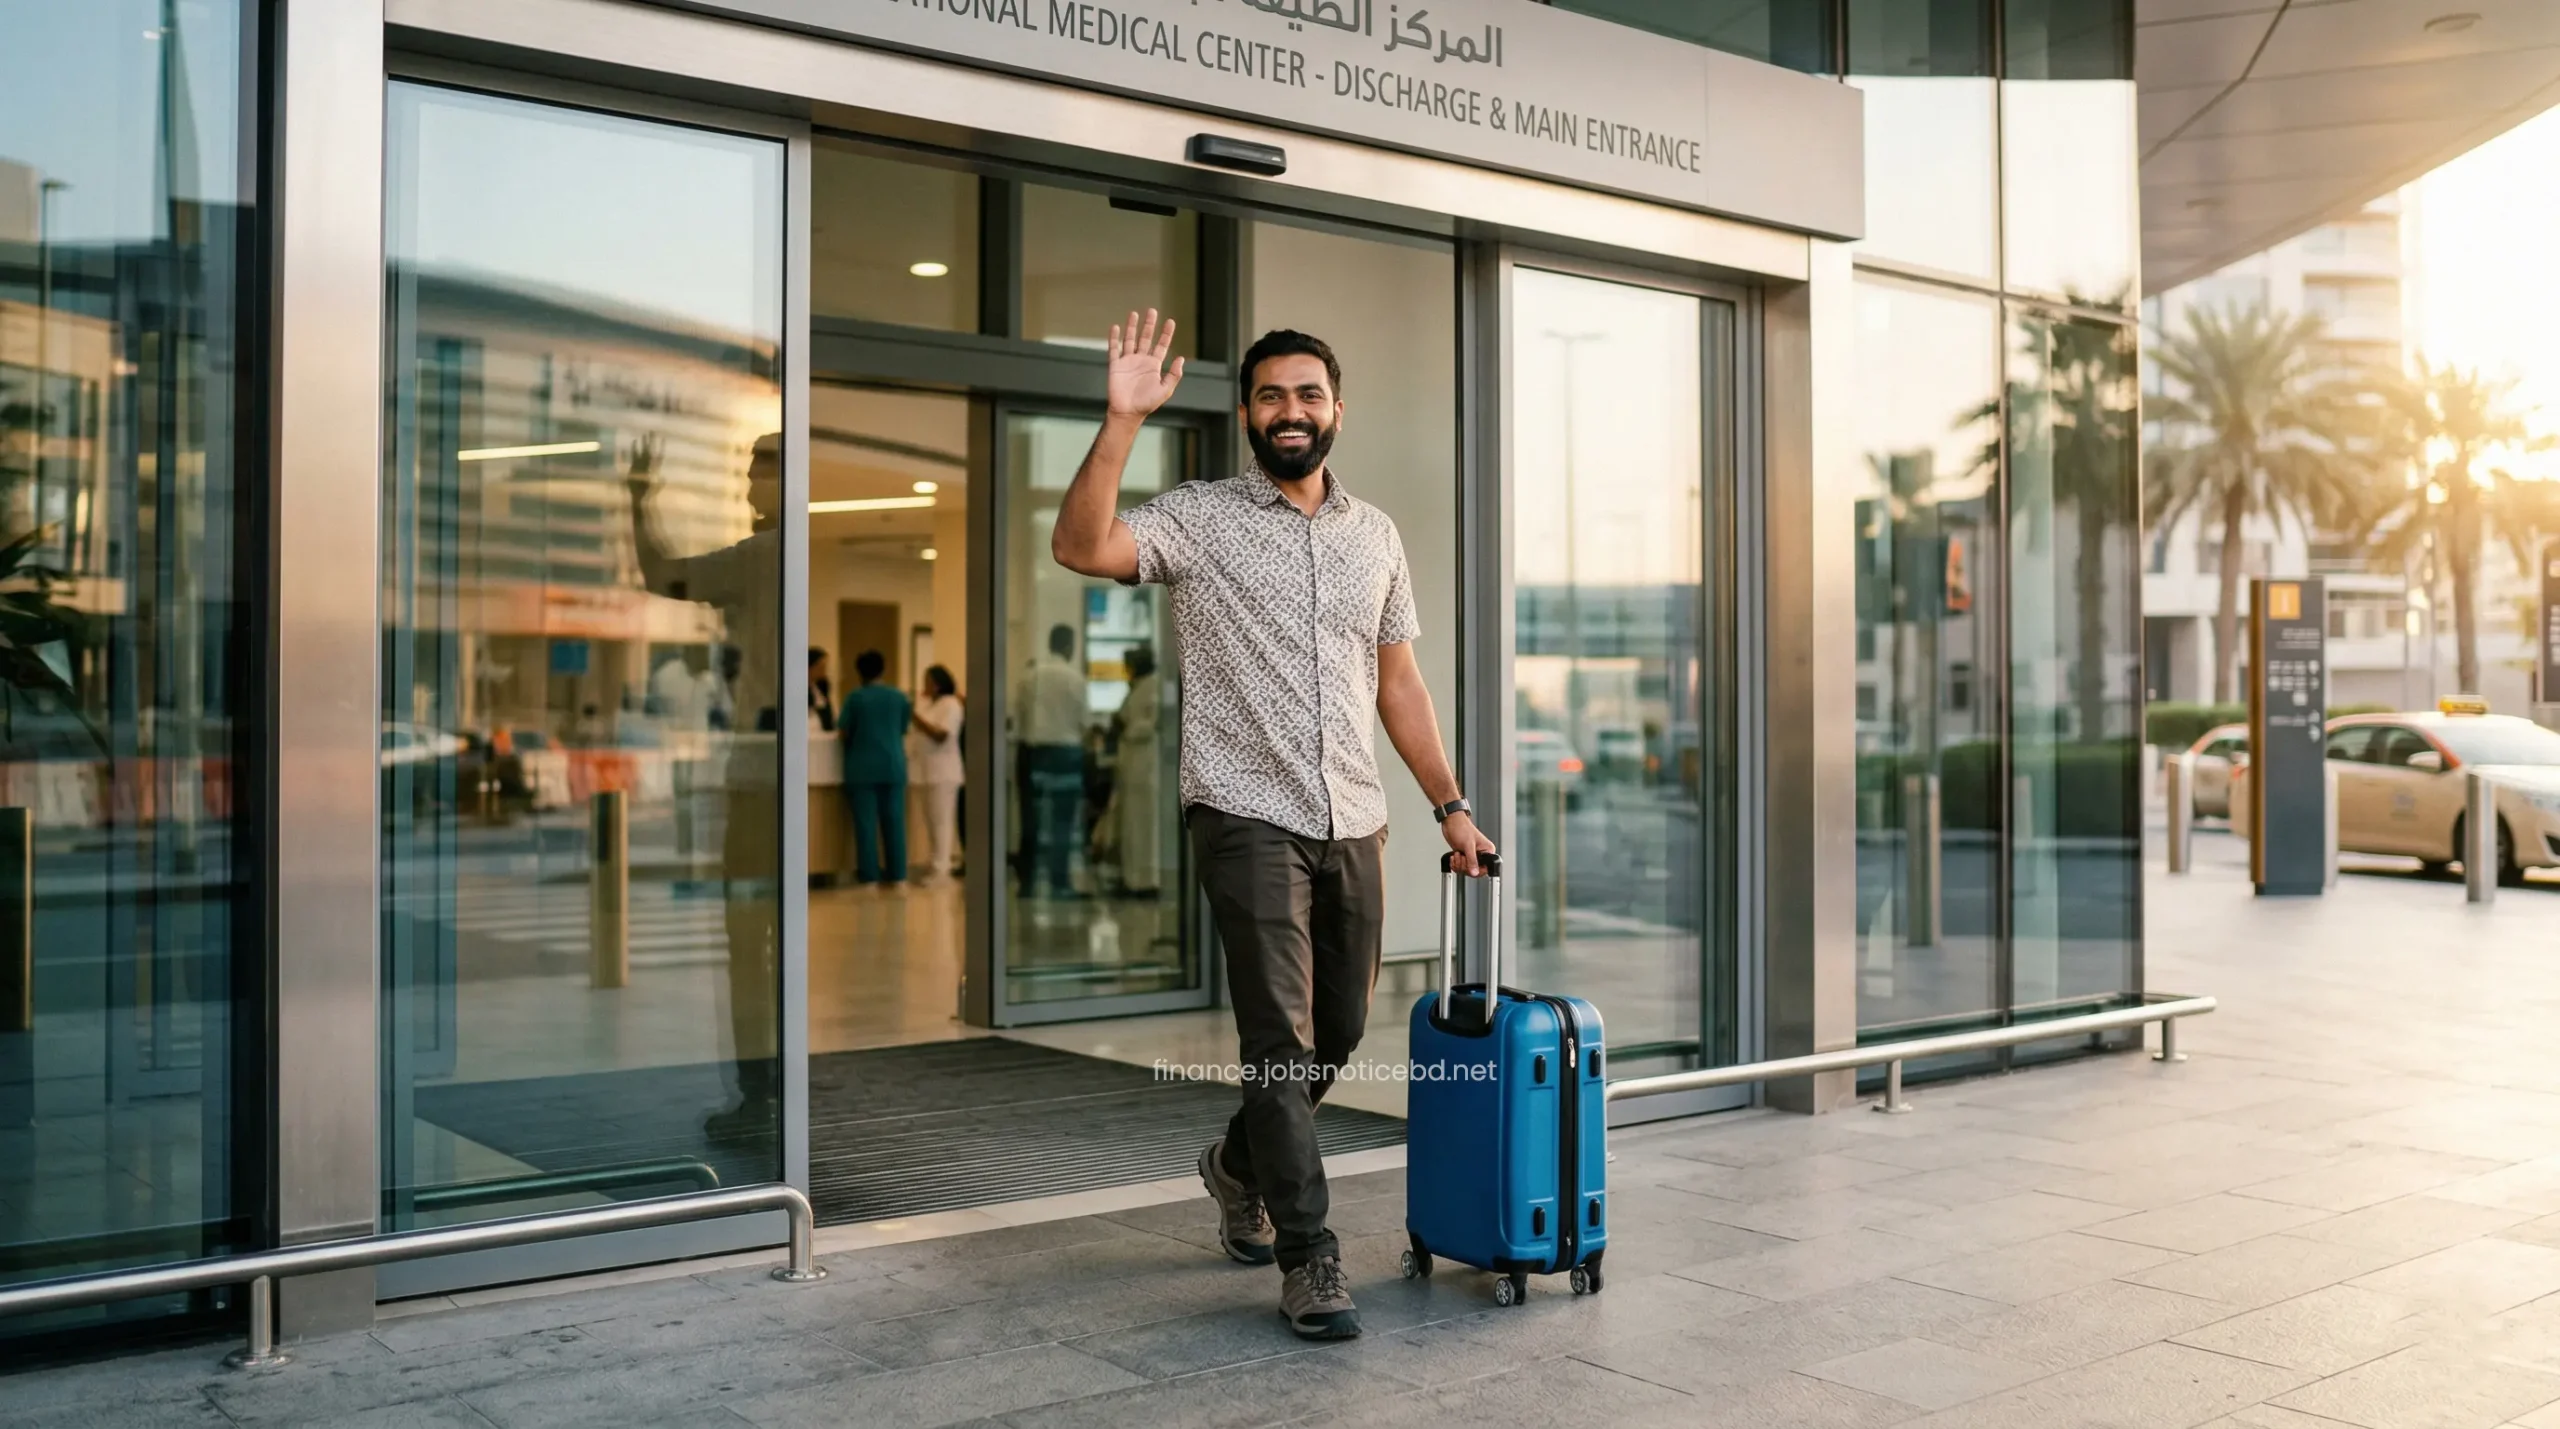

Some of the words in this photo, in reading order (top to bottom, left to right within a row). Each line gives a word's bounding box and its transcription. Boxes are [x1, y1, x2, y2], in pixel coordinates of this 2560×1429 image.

[1049, 0, 1187, 63] MEDICAL
[1196, 31, 1306, 88] CENTER
[1314, 73, 1325, 81] -
[1334, 60, 1481, 126] DISCHARGE
[1489, 96, 1506, 131] &
[1515, 101, 1577, 147] MAIN
[1586, 117, 1701, 174] ENTRANCE
[1383, 4, 1502, 67] المركز
